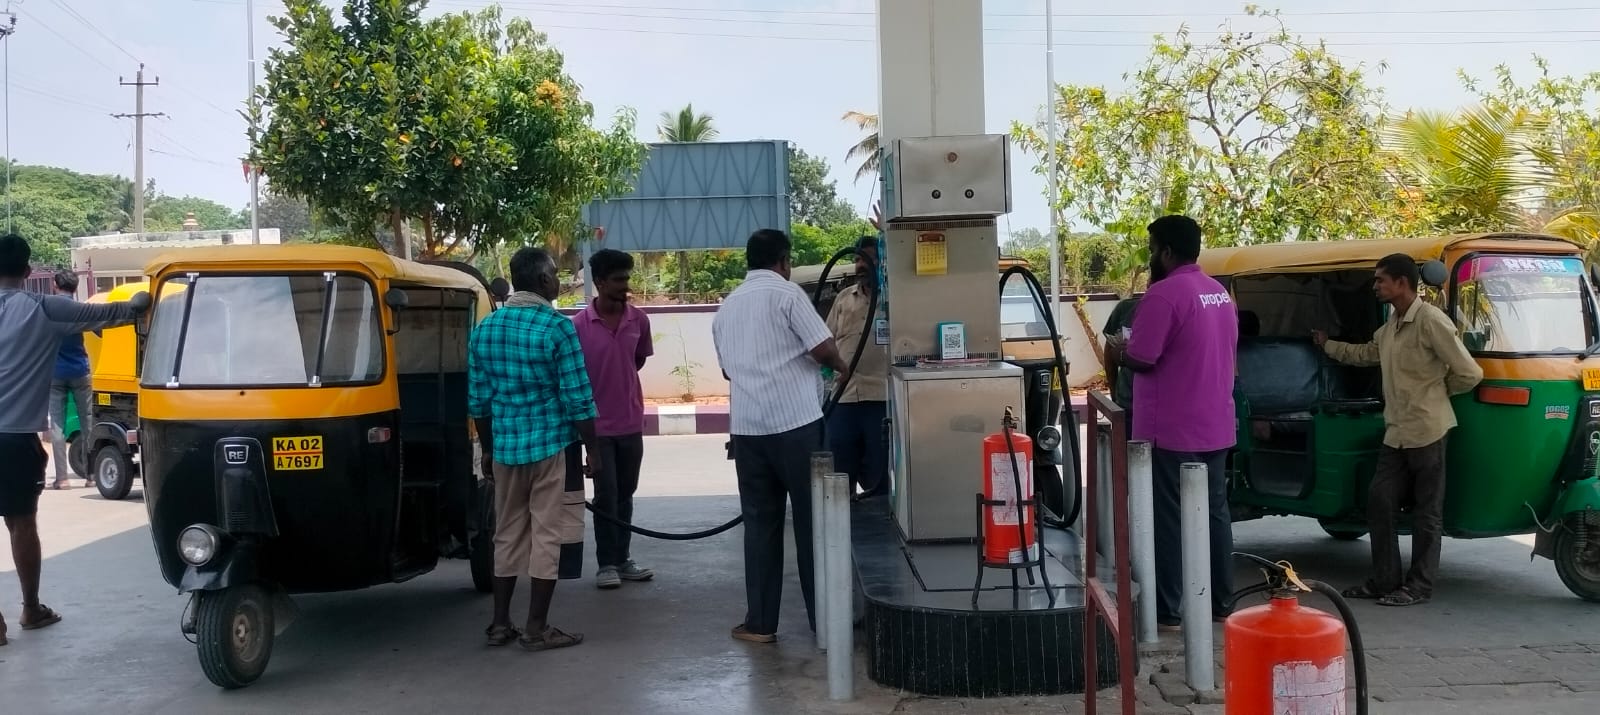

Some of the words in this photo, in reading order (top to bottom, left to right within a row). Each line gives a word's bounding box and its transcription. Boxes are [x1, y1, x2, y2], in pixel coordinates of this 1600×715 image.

[276, 439, 297, 451] KA
[300, 438, 320, 451] 02
[228, 451, 245, 460] RE
[277, 455, 320, 469] A7697
